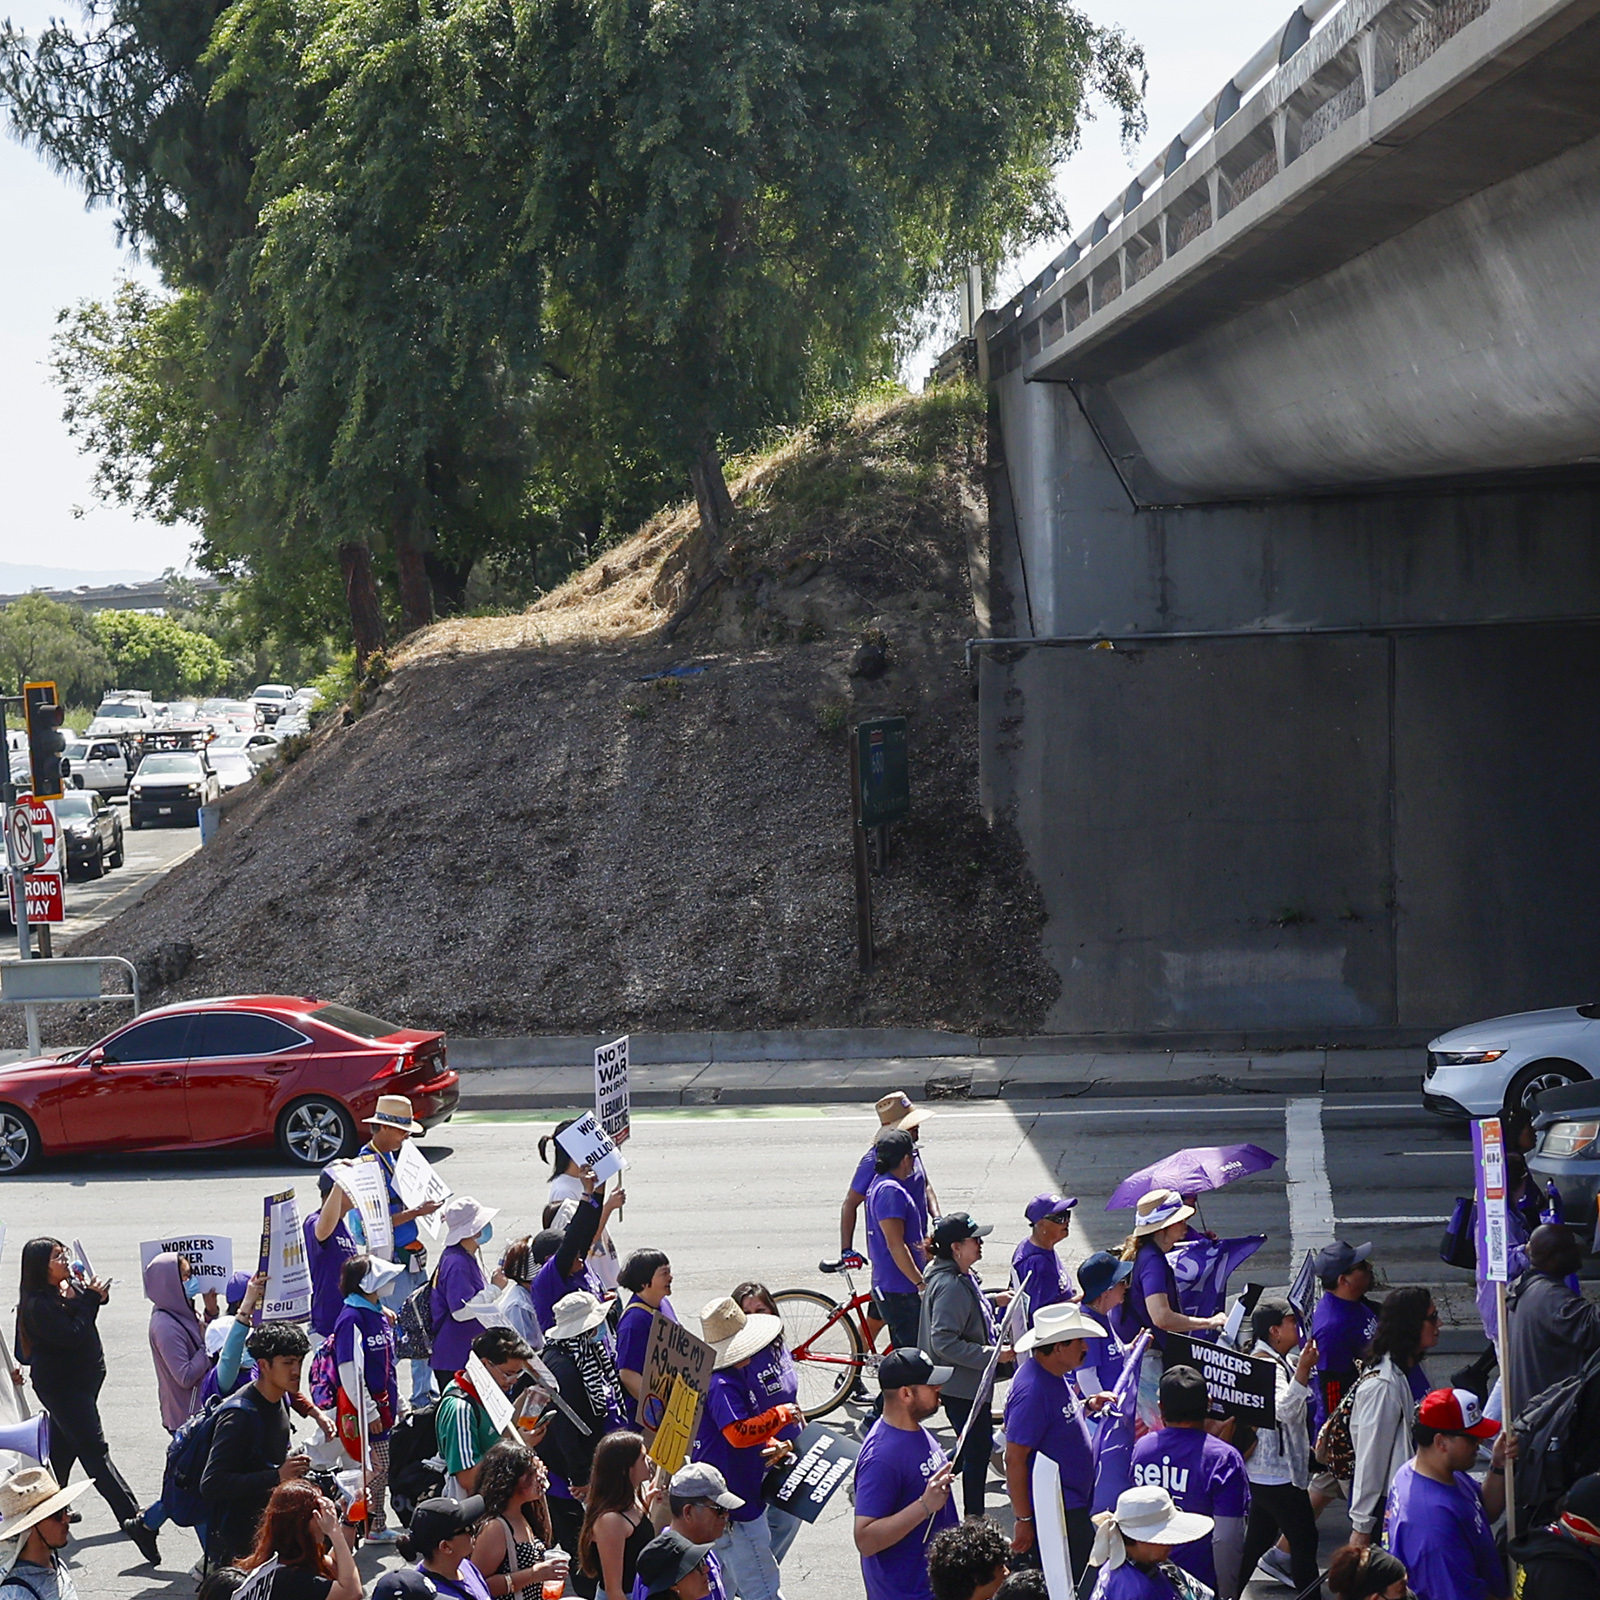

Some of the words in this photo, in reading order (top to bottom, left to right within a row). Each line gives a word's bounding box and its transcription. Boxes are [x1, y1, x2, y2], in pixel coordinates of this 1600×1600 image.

[598, 1048, 615, 1066] NO
[617, 1041, 627, 1058] TO
[598, 1058, 627, 1084] WAR
[599, 1083, 613, 1097] ON
[613, 1075, 628, 1093] IRAN
[161, 1239, 214, 1253] WORKERS
[265, 1300, 293, 1313] seiu
[656, 1318, 668, 1342] I
[668, 1324, 690, 1357] like
[690, 1348, 706, 1373] my
[1190, 1343, 1252, 1376] WORKERS
[1203, 1364, 1236, 1388] OVER
[668, 1381, 696, 1430] ICE
[654, 1421, 690, 1471] OUT
[776, 1434, 836, 1502] BILLIONAIRES!
[803, 1458, 832, 1487] OVER
[1019, 1450, 1042, 1476] seiu
[1134, 1455, 1189, 1493] seiu
[809, 1456, 853, 1504] WORKERS
